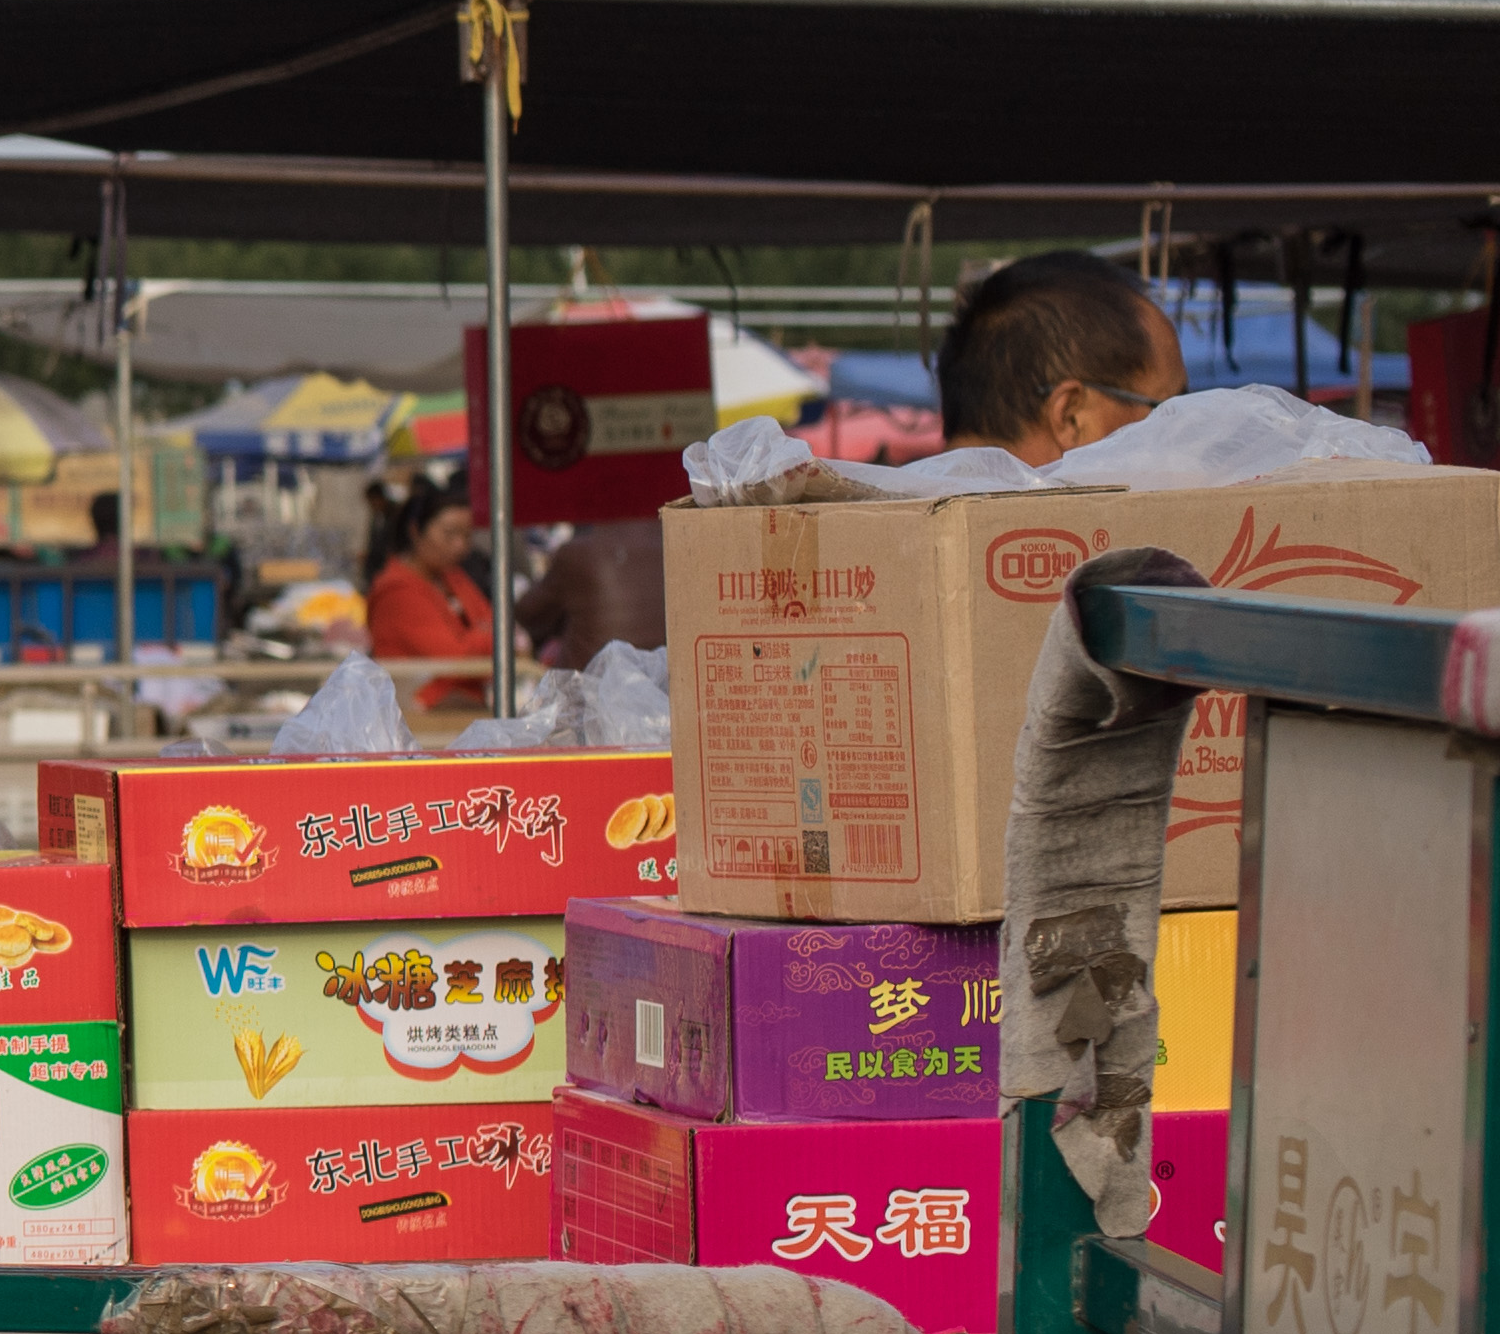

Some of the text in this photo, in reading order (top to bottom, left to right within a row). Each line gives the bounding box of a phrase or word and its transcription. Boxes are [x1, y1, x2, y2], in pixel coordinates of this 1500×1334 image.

[298, 785, 567, 867] 东北手工酥饼
[247, 973, 284, 992] 旺丰
[407, 1024, 499, 1044] 烘烤类糕点
[30, 1061, 108, 1081] 超市专供
[825, 1047, 982, 1080] 民以食为天
[772, 1188, 970, 1261] 天福
